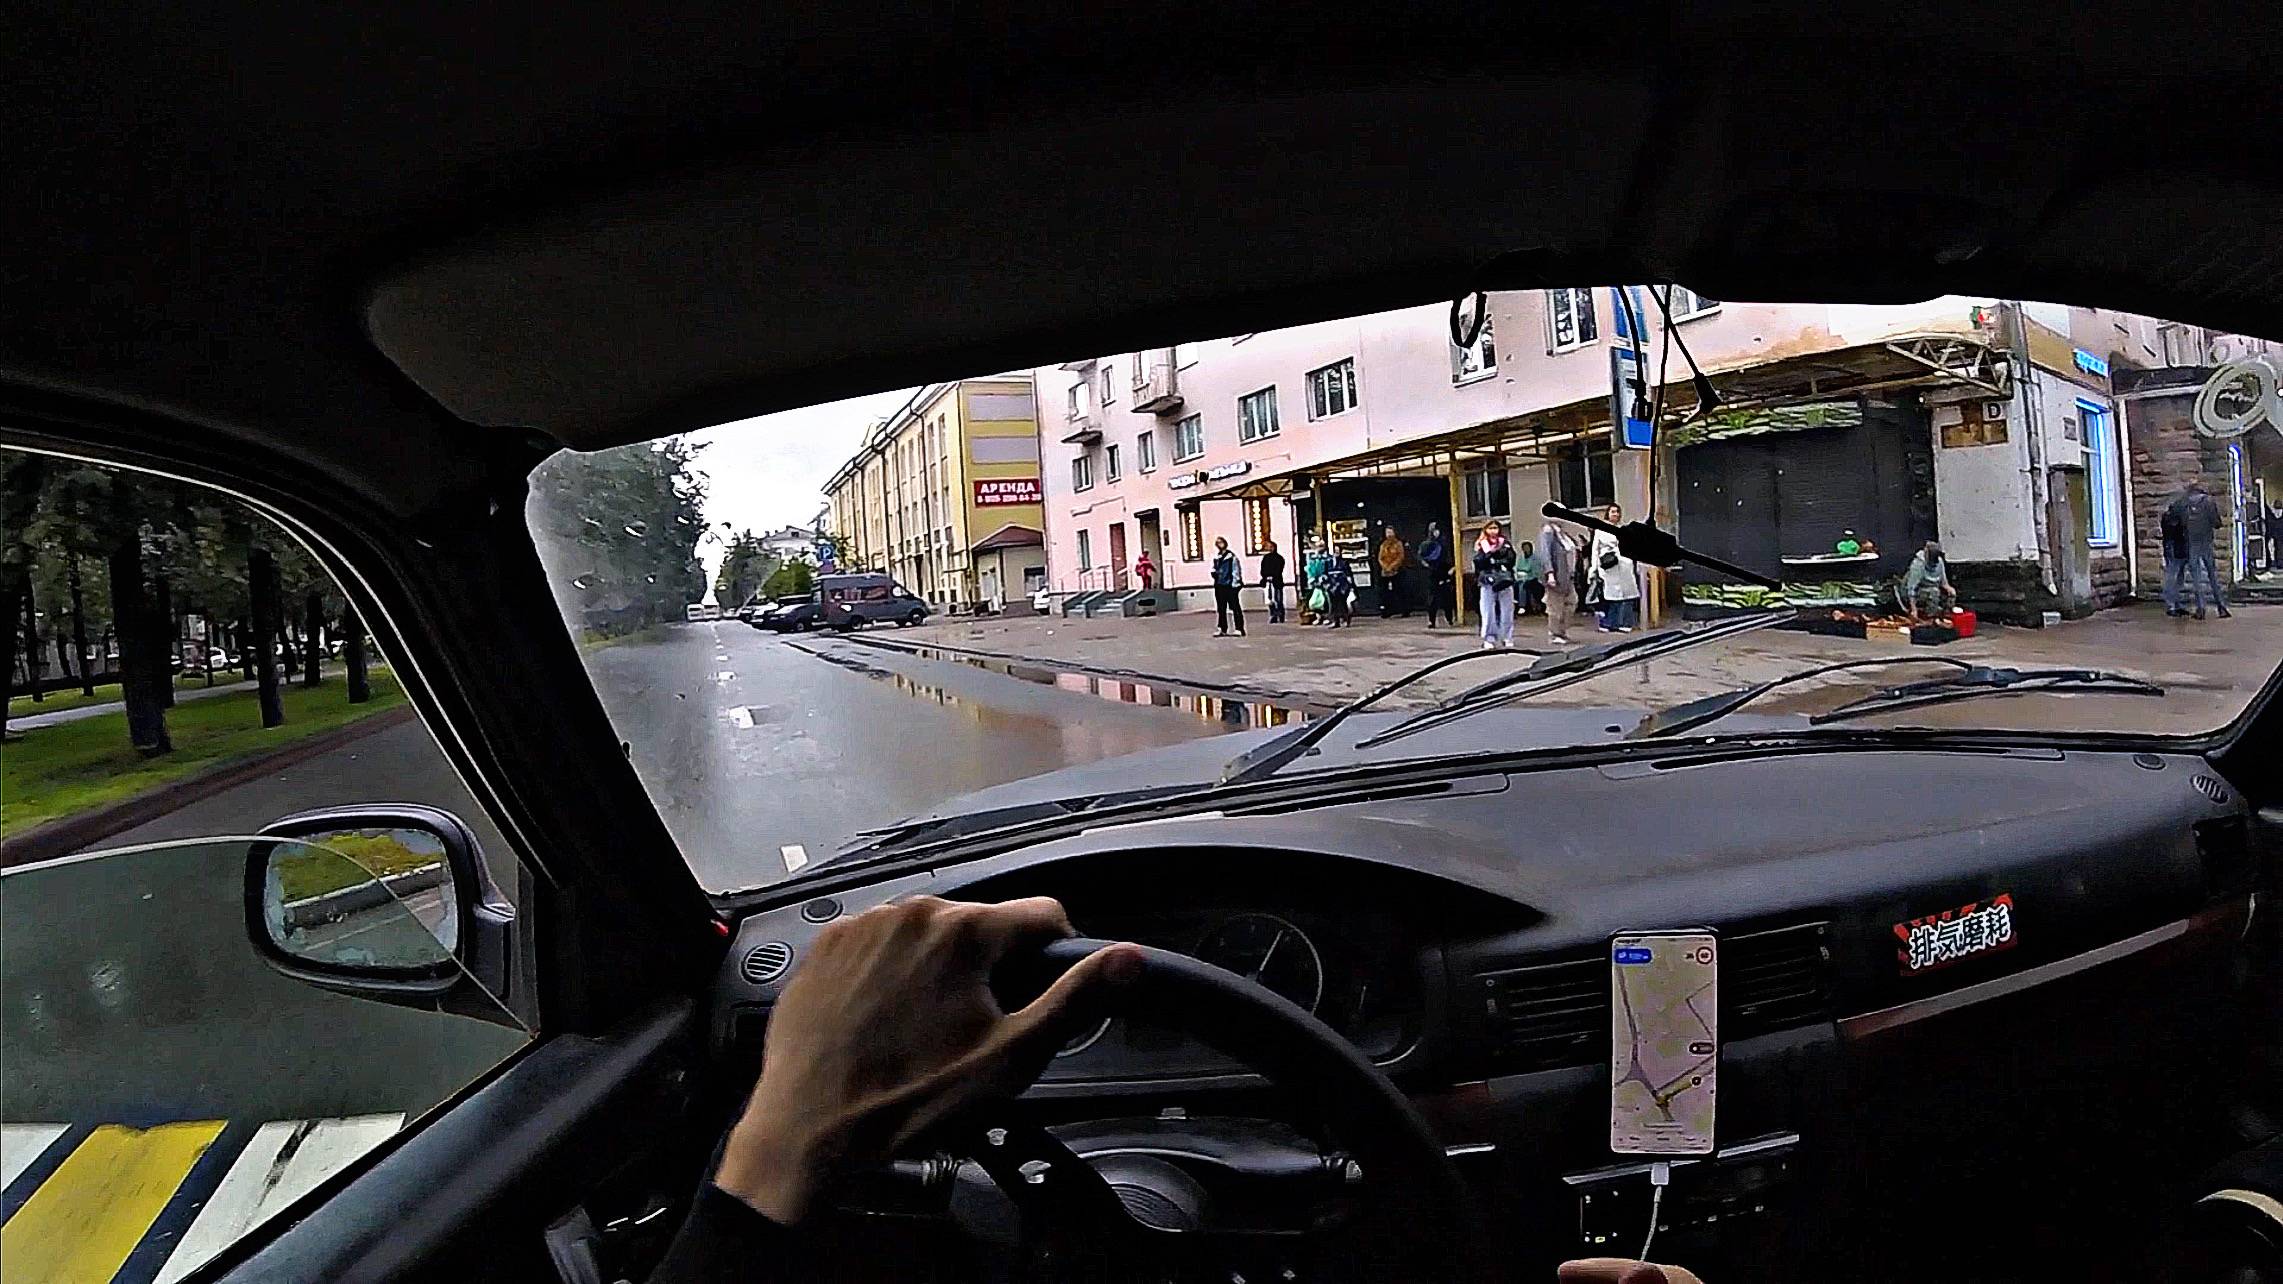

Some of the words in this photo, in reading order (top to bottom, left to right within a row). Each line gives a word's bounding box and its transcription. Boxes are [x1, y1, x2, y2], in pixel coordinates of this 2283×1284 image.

[980, 482, 1036, 494] АРЕНДА
[1909, 904, 2011, 969] 排気磨耗
